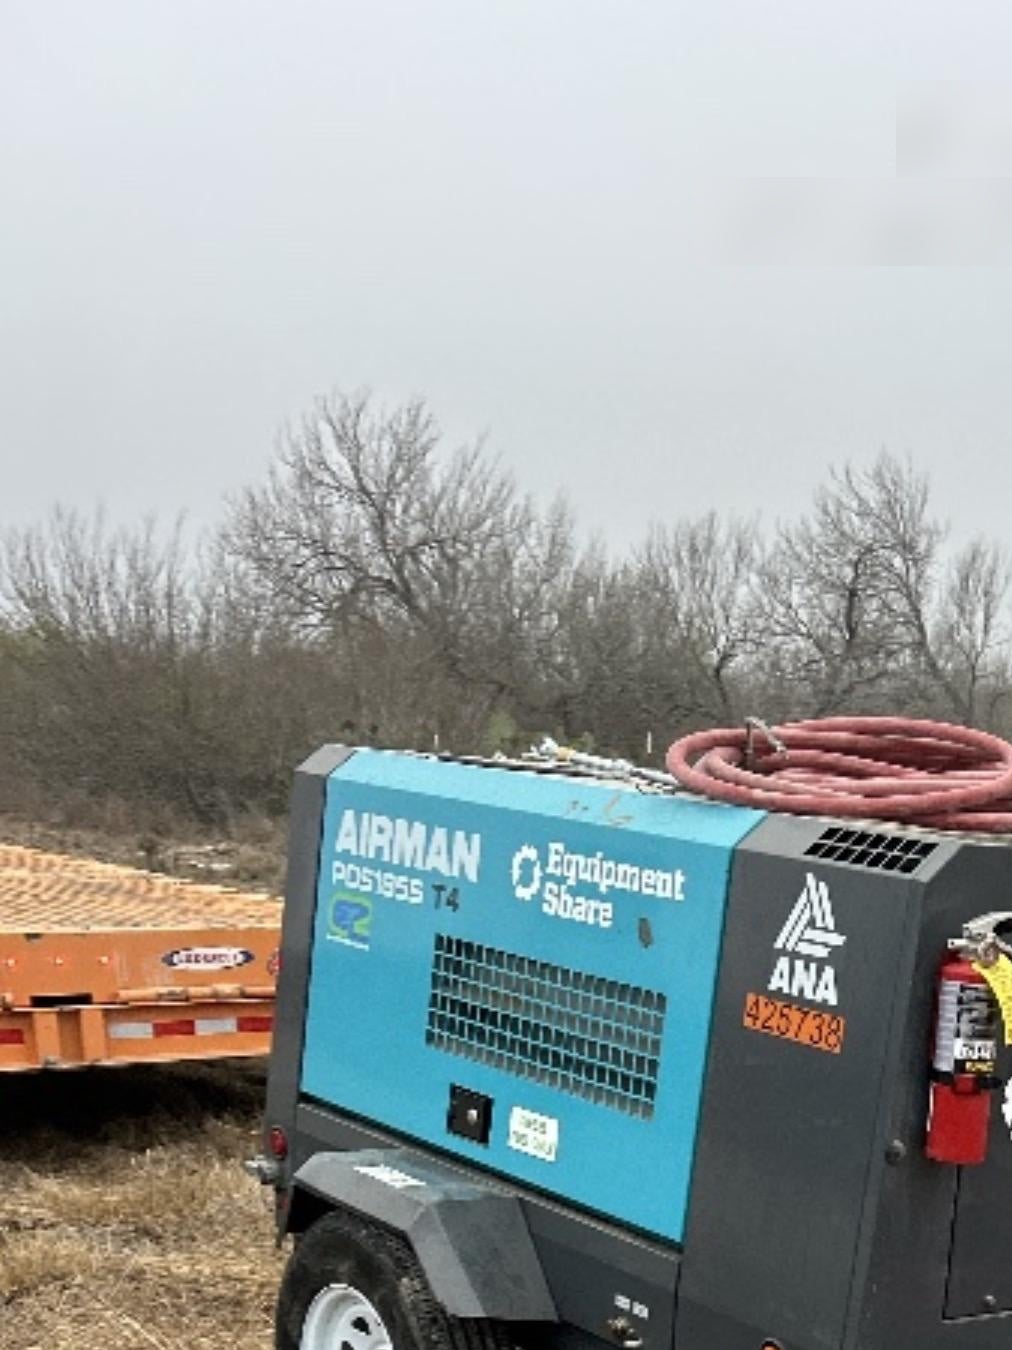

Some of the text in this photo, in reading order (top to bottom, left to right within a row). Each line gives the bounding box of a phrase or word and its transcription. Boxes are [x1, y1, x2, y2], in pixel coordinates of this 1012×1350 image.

[335, 808, 482, 883] AIRMAN
[545, 842, 686, 902] Equipment
[431, 883, 460, 913] T4
[541, 881, 614, 928] Share
[767, 956, 838, 1006] ANA
[744, 996, 843, 1049] 425738
